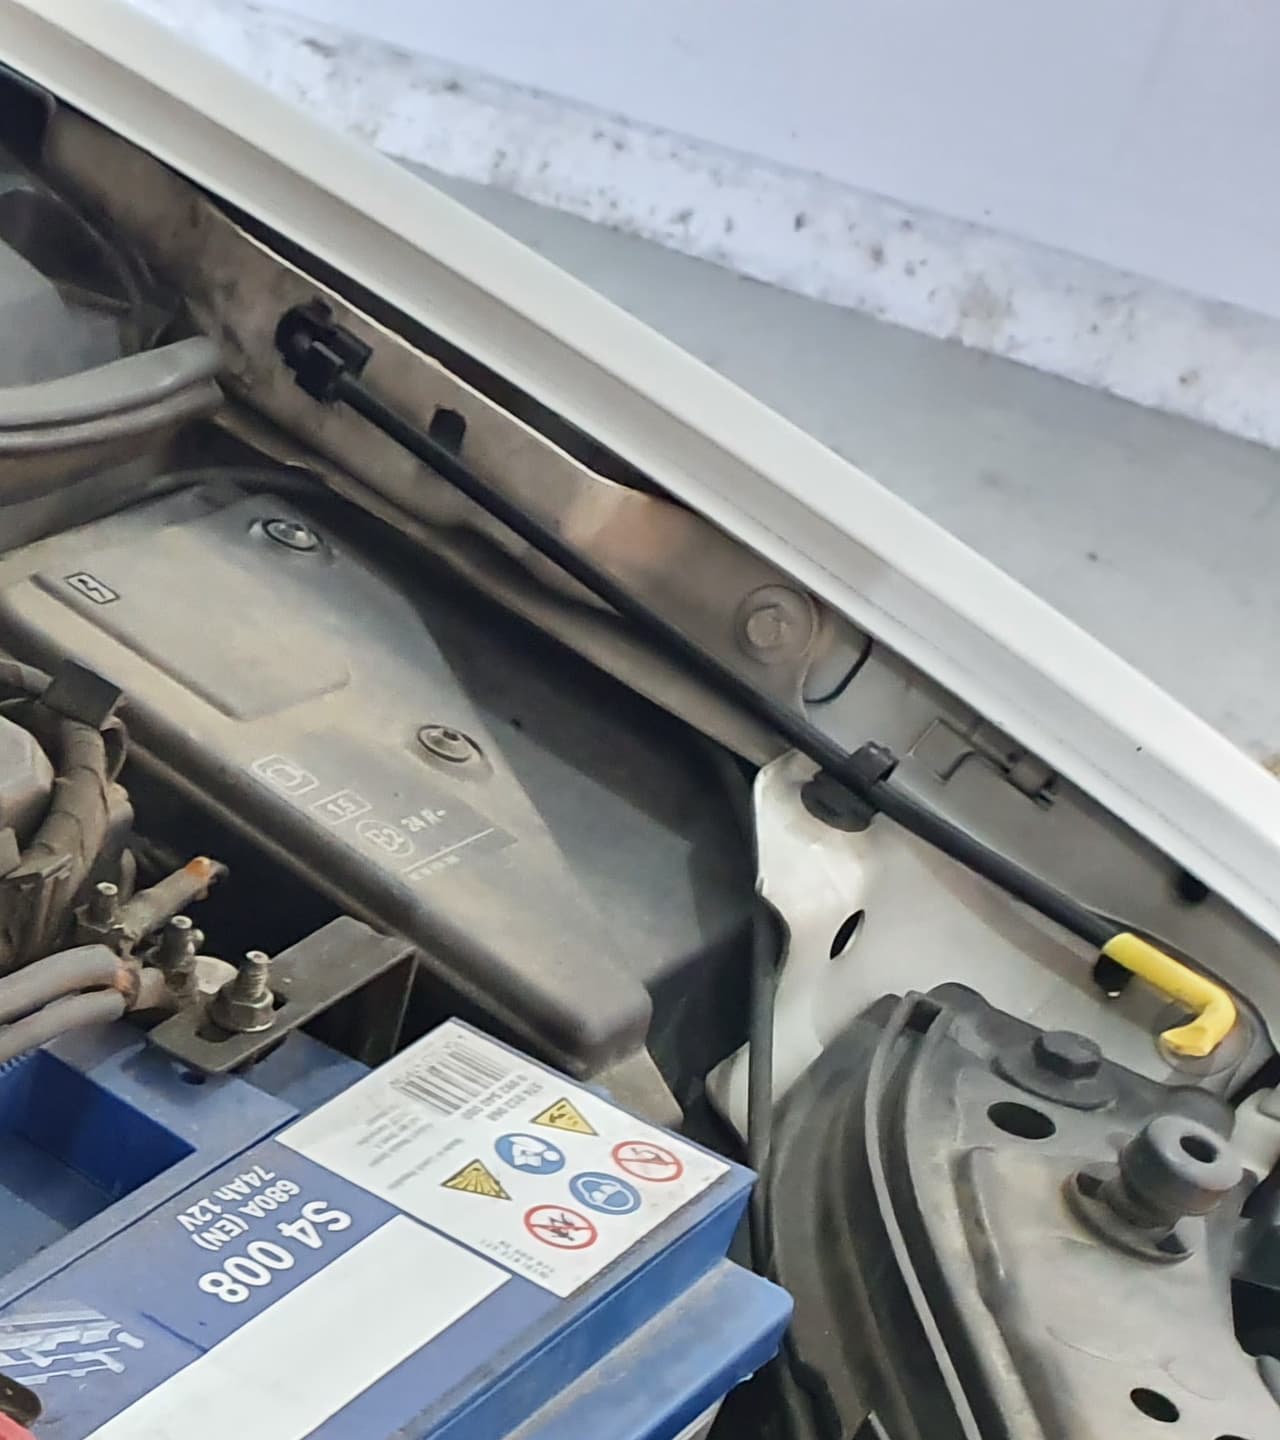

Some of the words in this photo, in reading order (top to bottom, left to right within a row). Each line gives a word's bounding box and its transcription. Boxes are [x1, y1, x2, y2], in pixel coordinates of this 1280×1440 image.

[213, 1165, 276, 1201] 74Ah
[237, 1179, 300, 1218] 680A
[176, 1198, 222, 1232] 12V
[191, 1213, 249, 1250] (EN)
[276, 1200, 352, 1249] S4
[198, 1240, 295, 1303] 008
